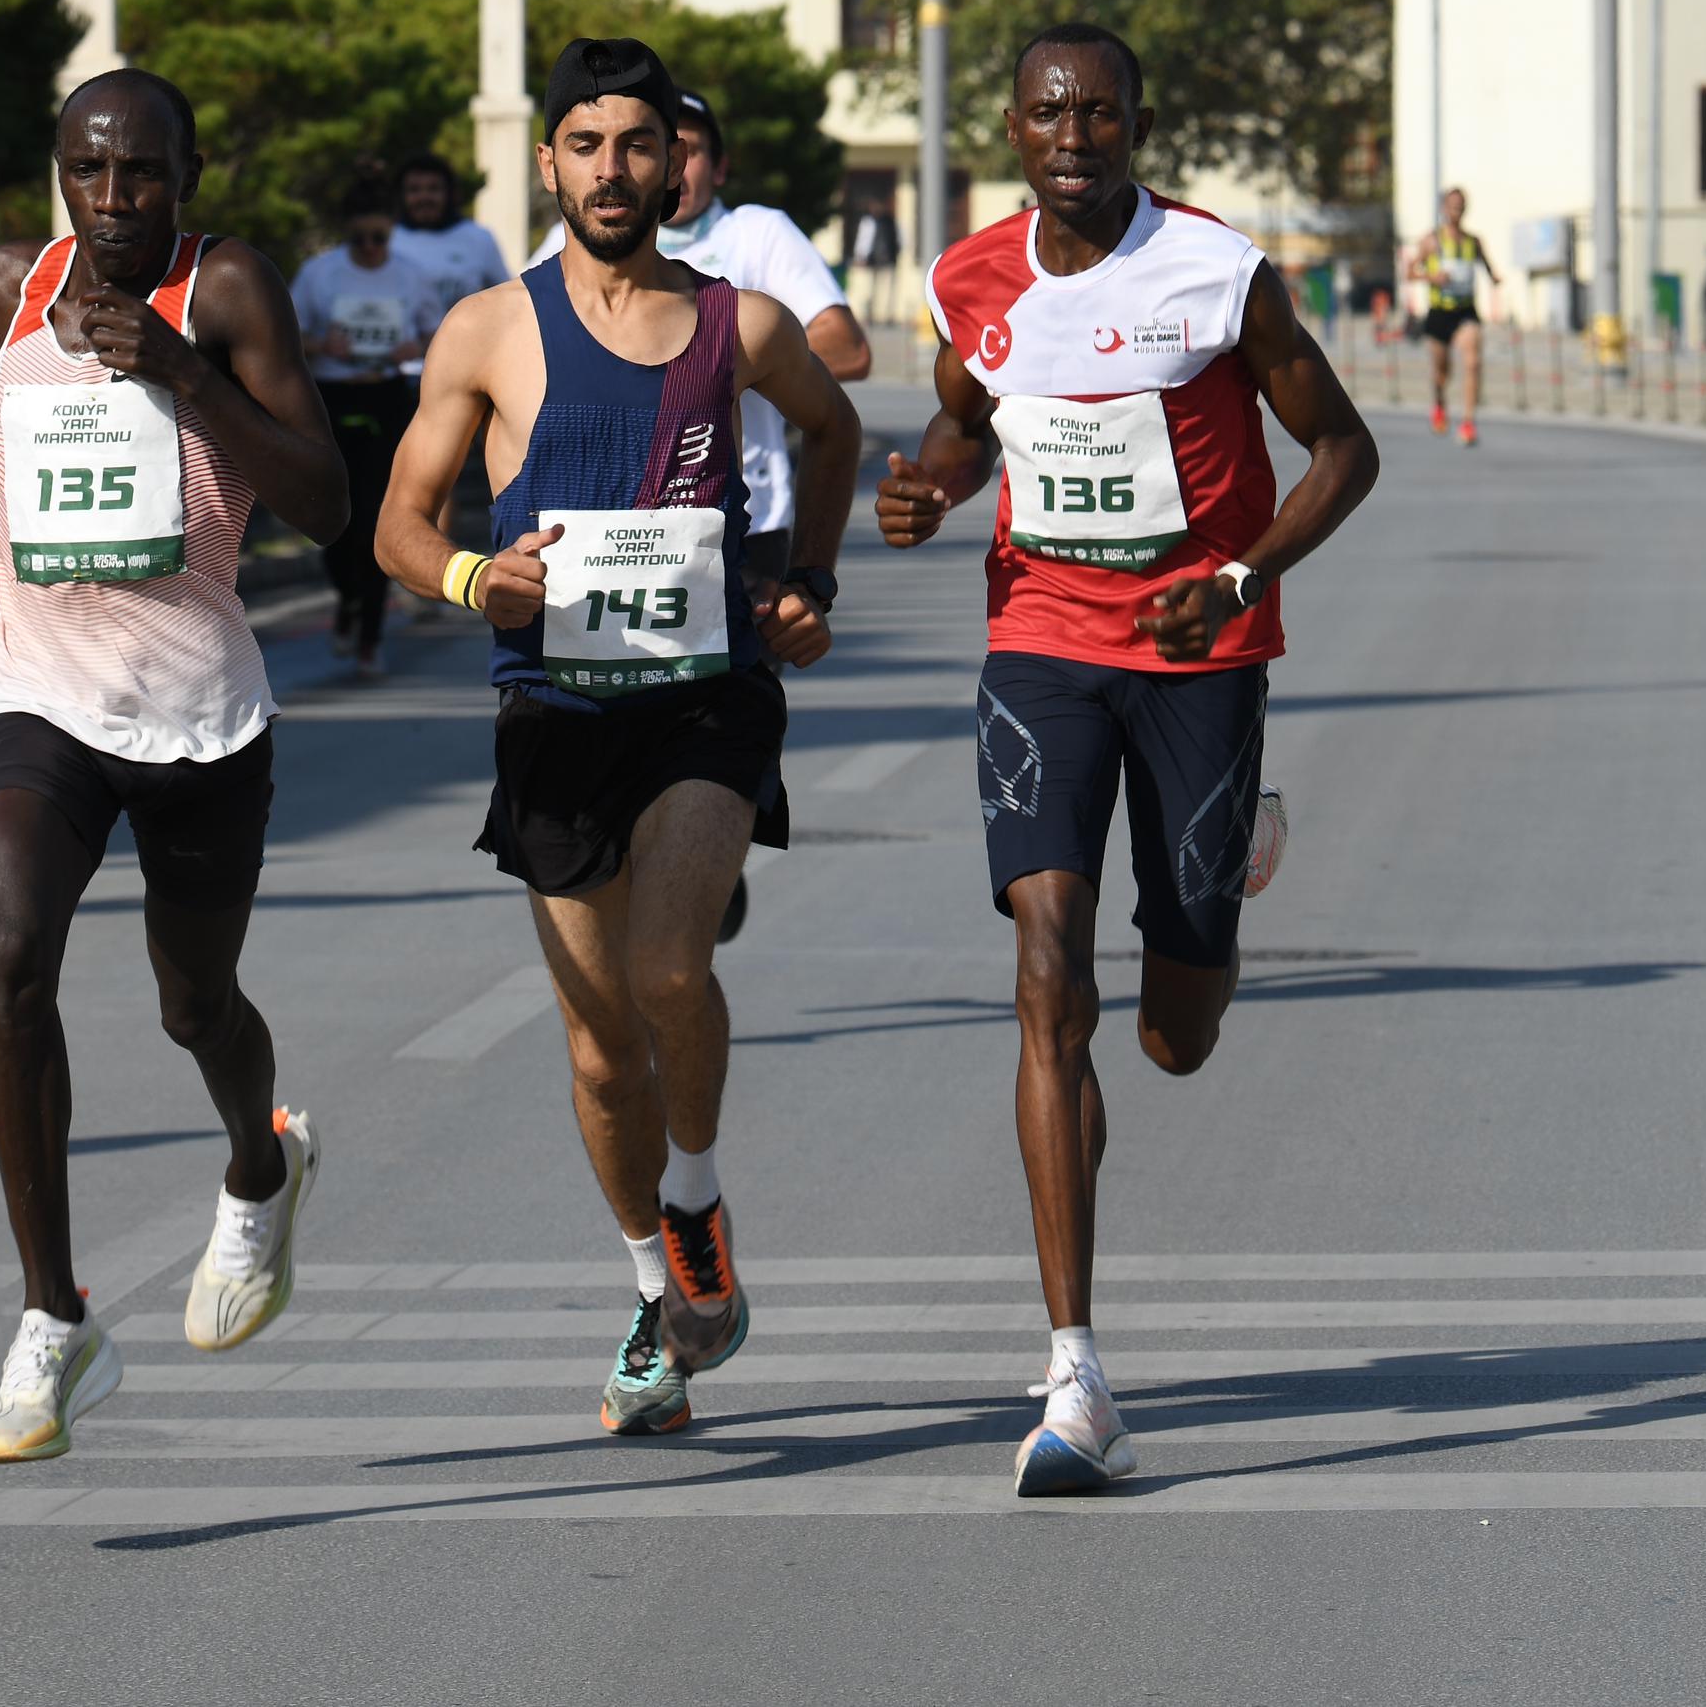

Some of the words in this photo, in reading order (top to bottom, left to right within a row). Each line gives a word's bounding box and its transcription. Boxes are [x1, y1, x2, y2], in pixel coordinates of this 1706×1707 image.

[1142, 333, 1154, 344] GÖÇ
[1157, 332, 1180, 342] İDARESİ
[53, 404, 108, 416] KONYA
[61, 418, 98, 430] YARI
[1050, 417, 1101, 432] KONYA
[34, 430, 132, 444] MARATONU
[1060, 430, 1092, 444] YARI
[1032, 442, 1126, 457] MARATONU
[37, 466, 137, 512] 135
[668, 477, 699, 488] COMP
[1038, 474, 1135, 513] 136
[605, 528, 665, 540] KONYA
[615, 541, 655, 553] YARI
[94, 559, 126, 568] KONYA
[584, 553, 686, 567] MARATONU
[586, 588, 688, 631] 143
[641, 676, 672, 684] KONYA
